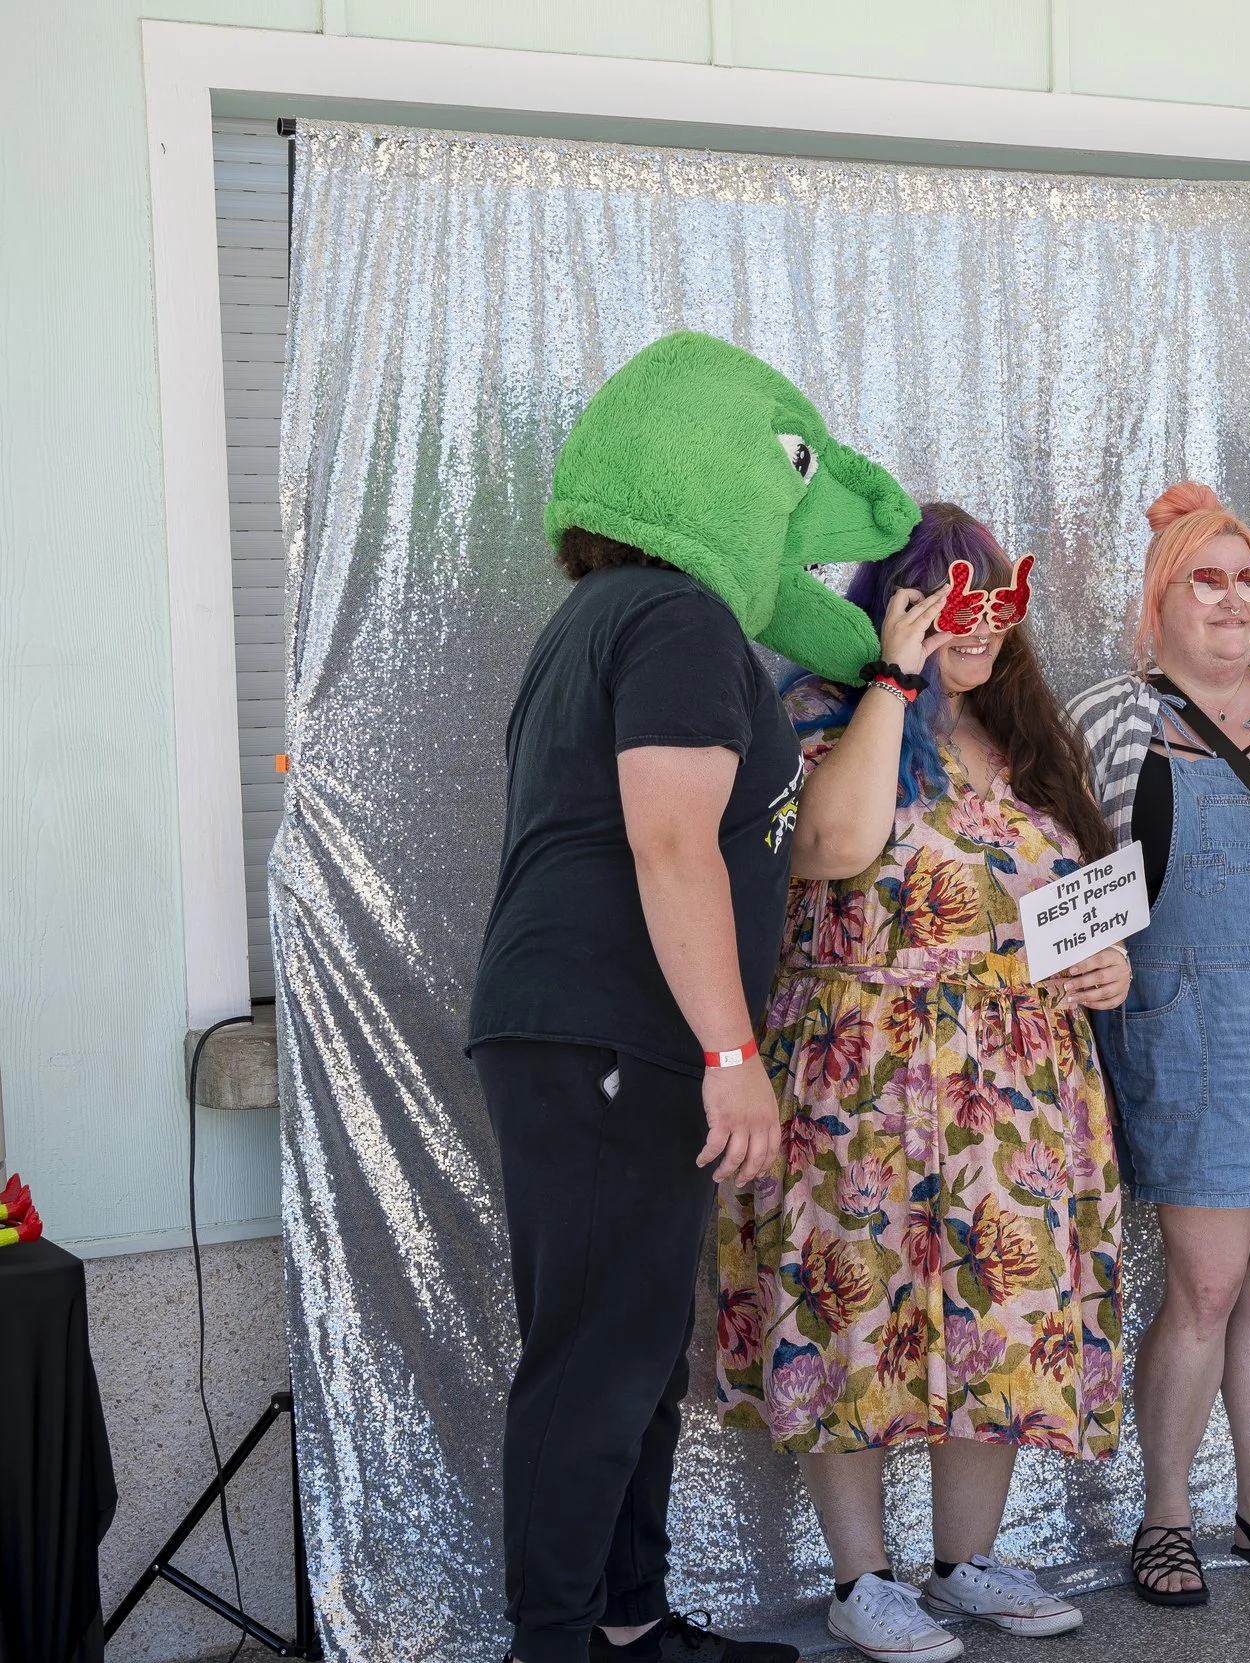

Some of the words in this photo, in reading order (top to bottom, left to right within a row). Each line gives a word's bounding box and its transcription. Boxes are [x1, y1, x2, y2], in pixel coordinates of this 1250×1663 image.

[1037, 895, 1079, 927] BEST
[1084, 871, 1136, 904] Person
[1057, 880, 1080, 899] I'm
[1084, 864, 1113, 884] The
[1053, 933, 1087, 954] This
[1090, 910, 1129, 937] Party
[1082, 906, 1098, 924] at
